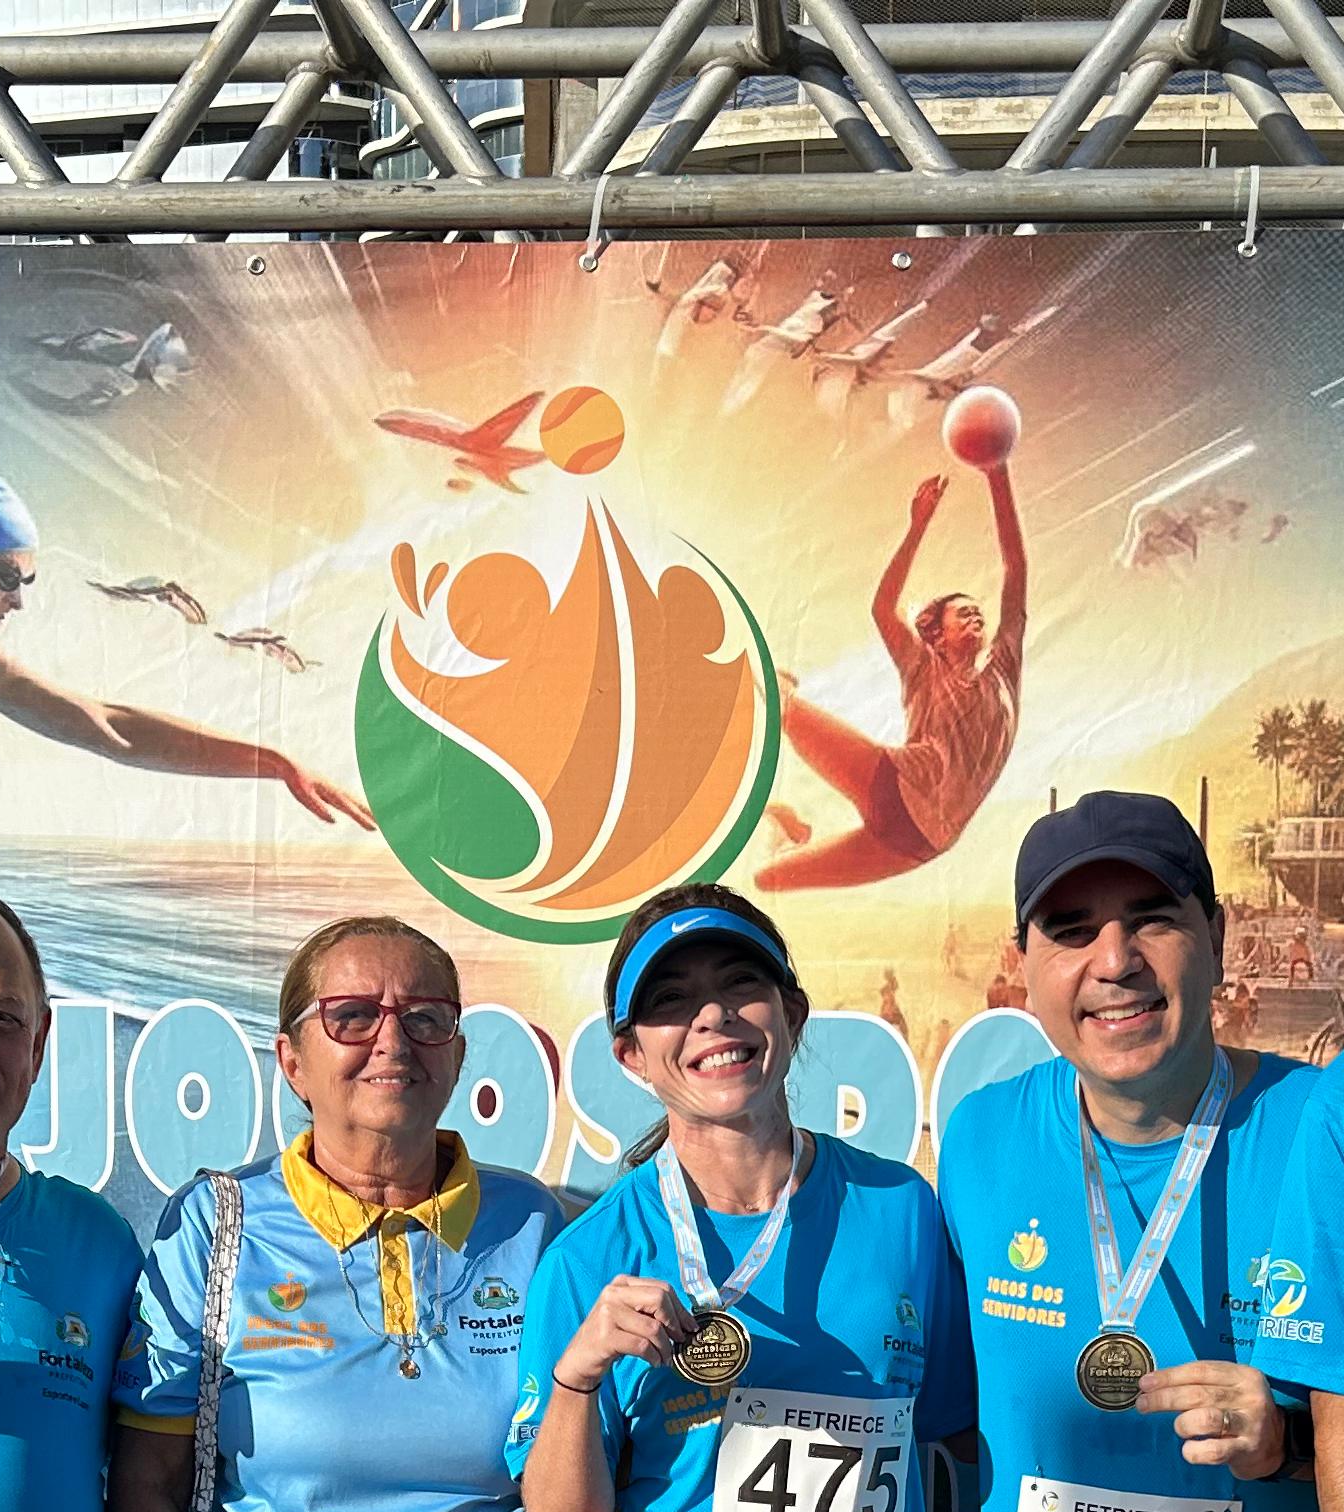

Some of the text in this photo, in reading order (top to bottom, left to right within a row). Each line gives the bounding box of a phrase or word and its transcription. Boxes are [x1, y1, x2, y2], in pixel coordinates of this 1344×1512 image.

[987, 1276, 1064, 1304] JOGOS DOS
[982, 1298, 1067, 1329] SERVIDORES
[469, 1345, 508, 1356] Esporte
[1089, 1366, 1142, 1377] Fortaleza
[785, 1408, 885, 1433] FETRIECE
